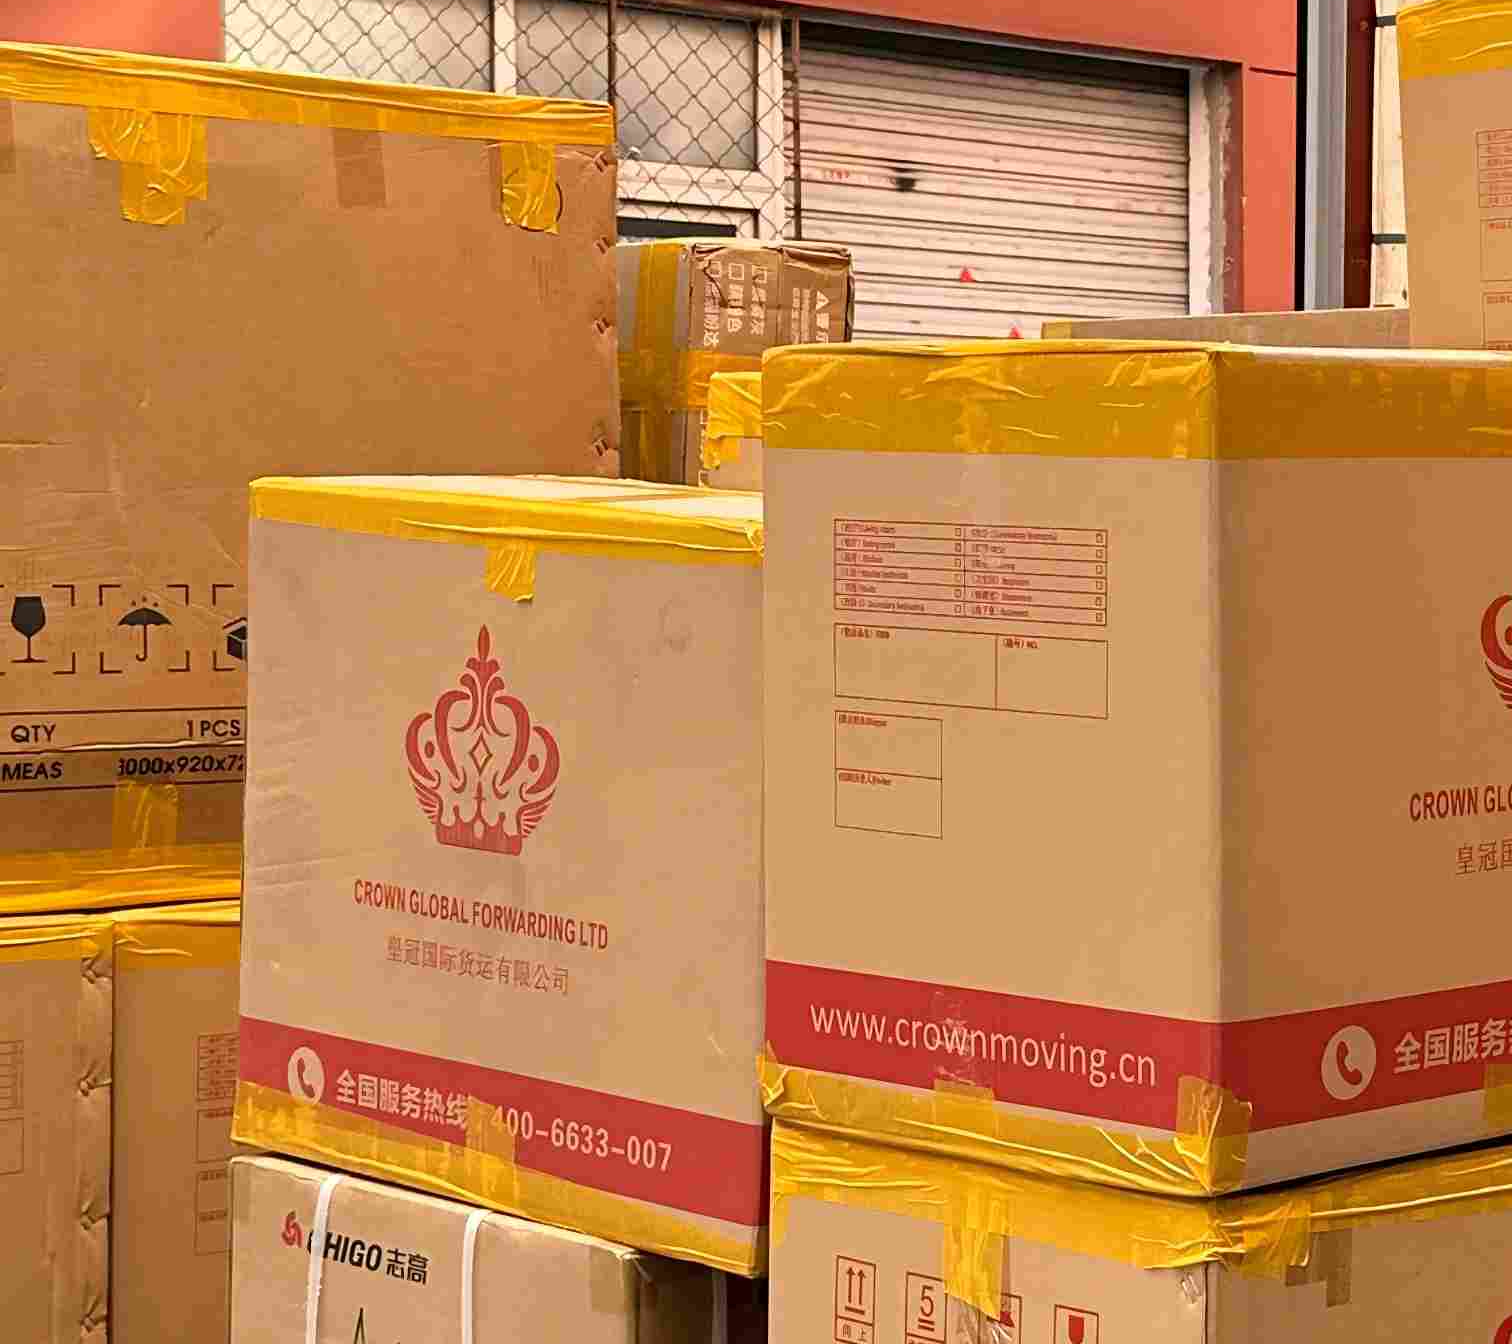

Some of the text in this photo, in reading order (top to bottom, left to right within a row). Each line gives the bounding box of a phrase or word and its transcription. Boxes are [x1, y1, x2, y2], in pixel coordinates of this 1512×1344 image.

[10, 724, 57, 744] QTY
[199, 719, 242, 737] PCS
[1, 761, 63, 782] MEAS
[1409, 787, 1479, 823] CROWN
[353, 879, 609, 951] CROWN GLOBAL FORWARDING LTD
[385, 935, 570, 996] 皇冠国际货运有限公司
[810, 1003, 1158, 1088] www.crownmoving.cn
[919, 1284, 935, 1317] 5
